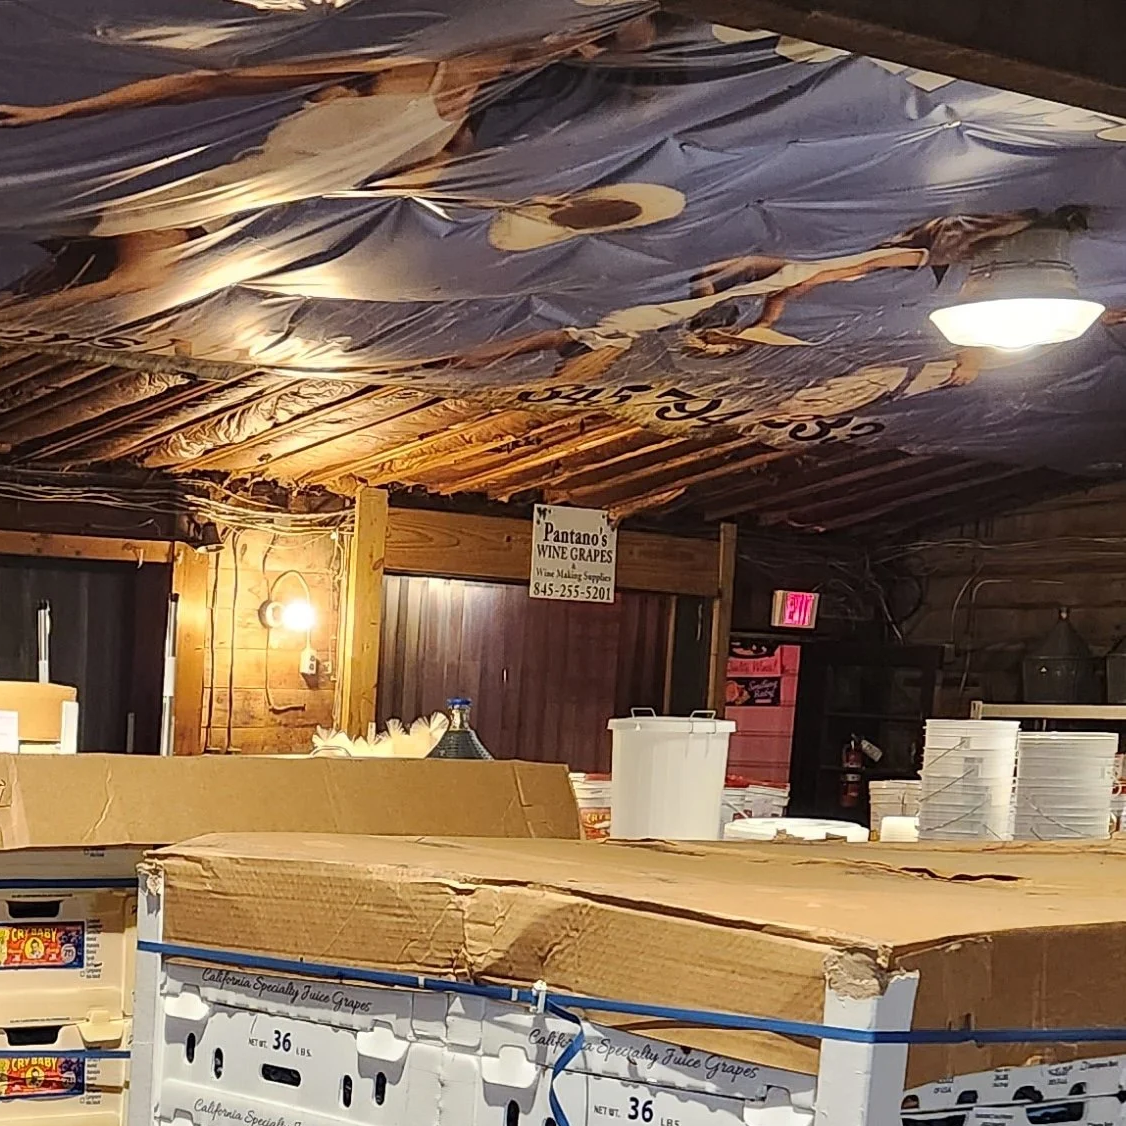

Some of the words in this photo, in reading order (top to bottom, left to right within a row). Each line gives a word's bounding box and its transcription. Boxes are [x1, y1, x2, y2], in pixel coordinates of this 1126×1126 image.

[543, 522, 608, 547] Pantano's
[537, 544, 568, 560] WINE
[570, 547, 612, 564] GRAPES
[536, 568, 554, 578] Wine
[556, 568, 582, 582] Making
[584, 571, 612, 584] Supplies
[534, 582, 611, 600] 845-255-5201
[12, 928, 30, 942] CRY
[32, 928, 57, 942] BABY
[202, 968, 251, 988] California
[252, 976, 300, 1002] Specialty
[302, 986, 330, 1004] Juice
[332, 991, 370, 1013] Grapes
[272, 1030, 292, 1052] 36
[12, 1058, 31, 1072] CRY
[32, 1057, 58, 1072] BABY
[194, 1099, 242, 1121] California
[628, 1097, 653, 1122] 36
